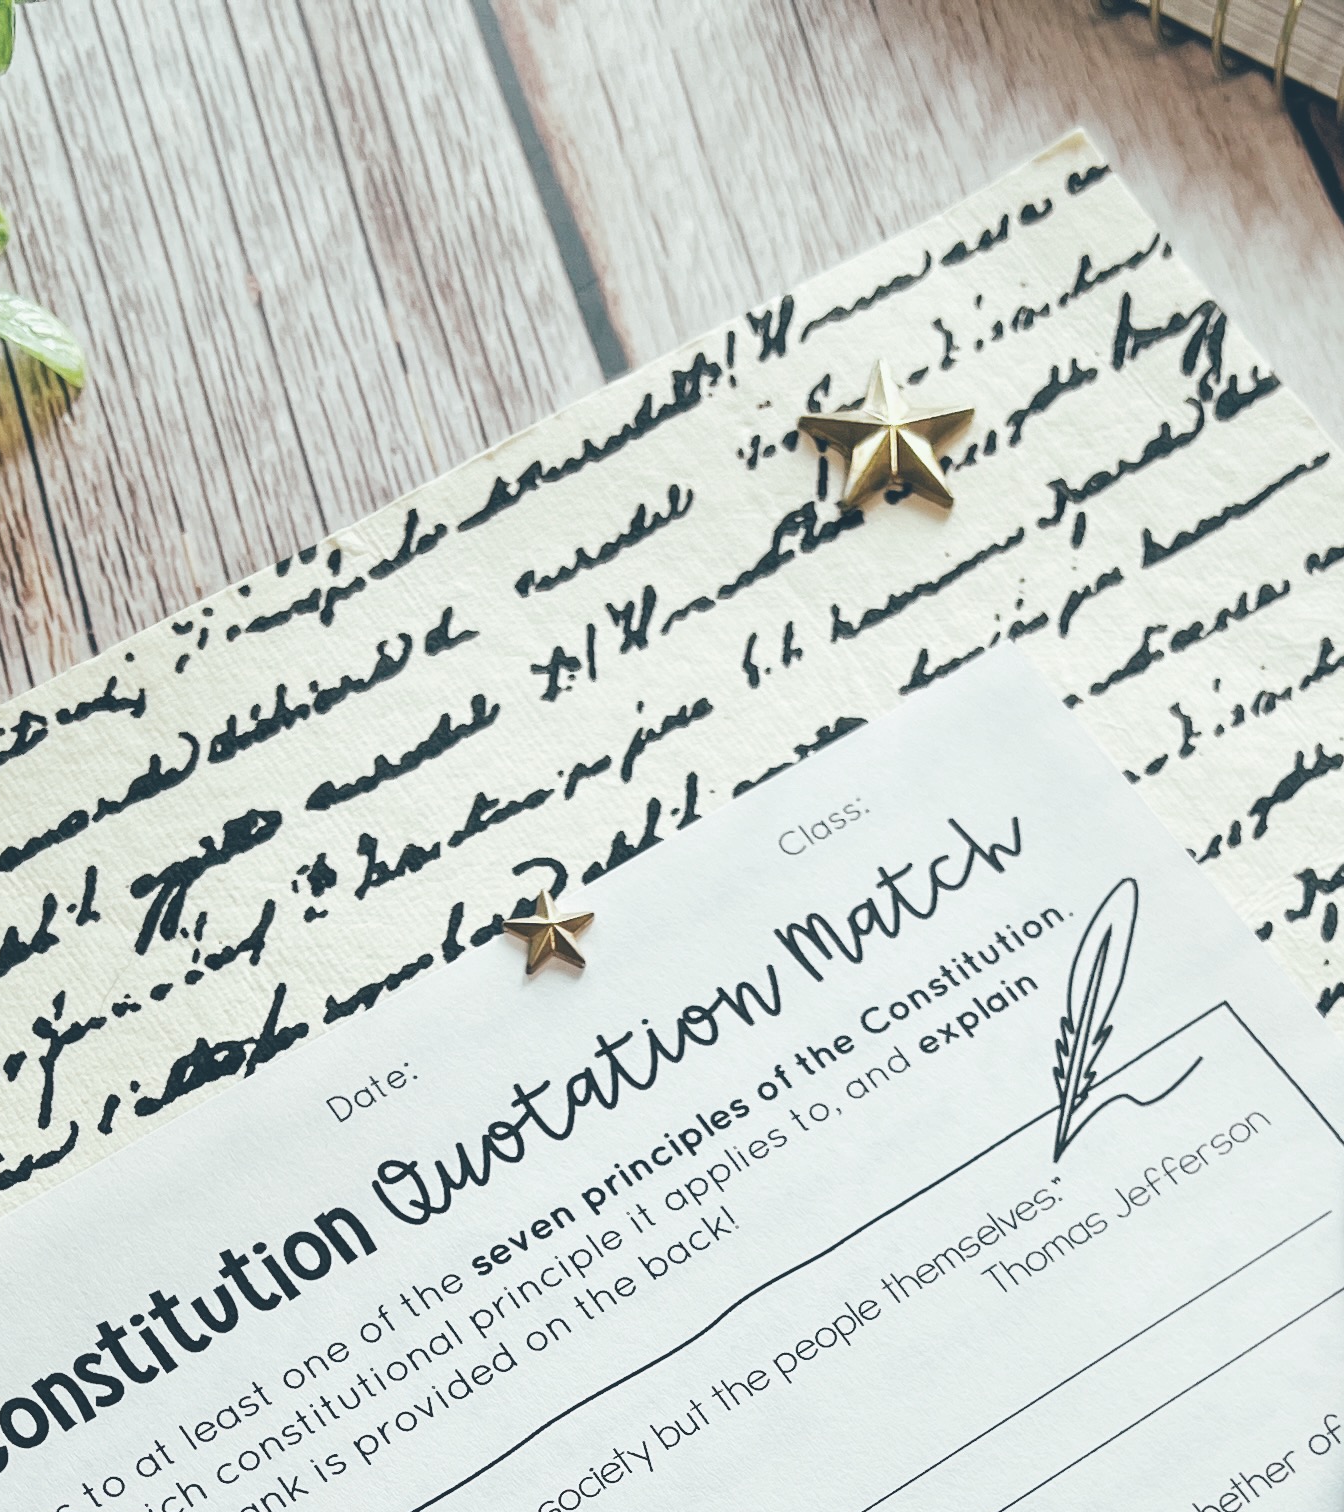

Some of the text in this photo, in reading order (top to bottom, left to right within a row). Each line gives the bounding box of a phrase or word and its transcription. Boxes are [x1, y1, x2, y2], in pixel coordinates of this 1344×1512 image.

[777, 796, 871, 857] Class:
[324, 1061, 419, 1124] Date:
[370, 963, 783, 1227] Quotation
[771, 815, 1023, 984] Match
[80, 1475, 127, 1509] to
[135, 1438, 176, 1479] at
[177, 1380, 274, 1452] least
[282, 1341, 351, 1390] one
[359, 1303, 397, 1344] of
[398, 1272, 464, 1318] the
[470, 1206, 577, 1277] seven
[580, 1097, 751, 1217] principles
[756, 1063, 794, 1102] of
[793, 1033, 856, 1077] the
[859, 907, 1075, 1035] Constitution.
[215, 1318, 464, 1485] constitutional
[468, 1229, 624, 1340] principle
[625, 1202, 657, 1235] it
[663, 1127, 789, 1212] applies
[788, 1101, 843, 1132] to,
[845, 1044, 912, 1100] and
[917, 975, 1040, 1055] explain
[979, 1110, 1273, 1294] Thomas Jefferson
[308, 1452, 348, 1484] is
[352, 1341, 519, 1467] provided
[525, 1317, 573, 1353] on
[572, 1275, 638, 1321] the
[636, 1204, 741, 1282] back!
[648, 1398, 711, 1451] but
[710, 1368, 772, 1412] the
[771, 1298, 883, 1385] people
[1307, 1413, 1342, 1457] of
